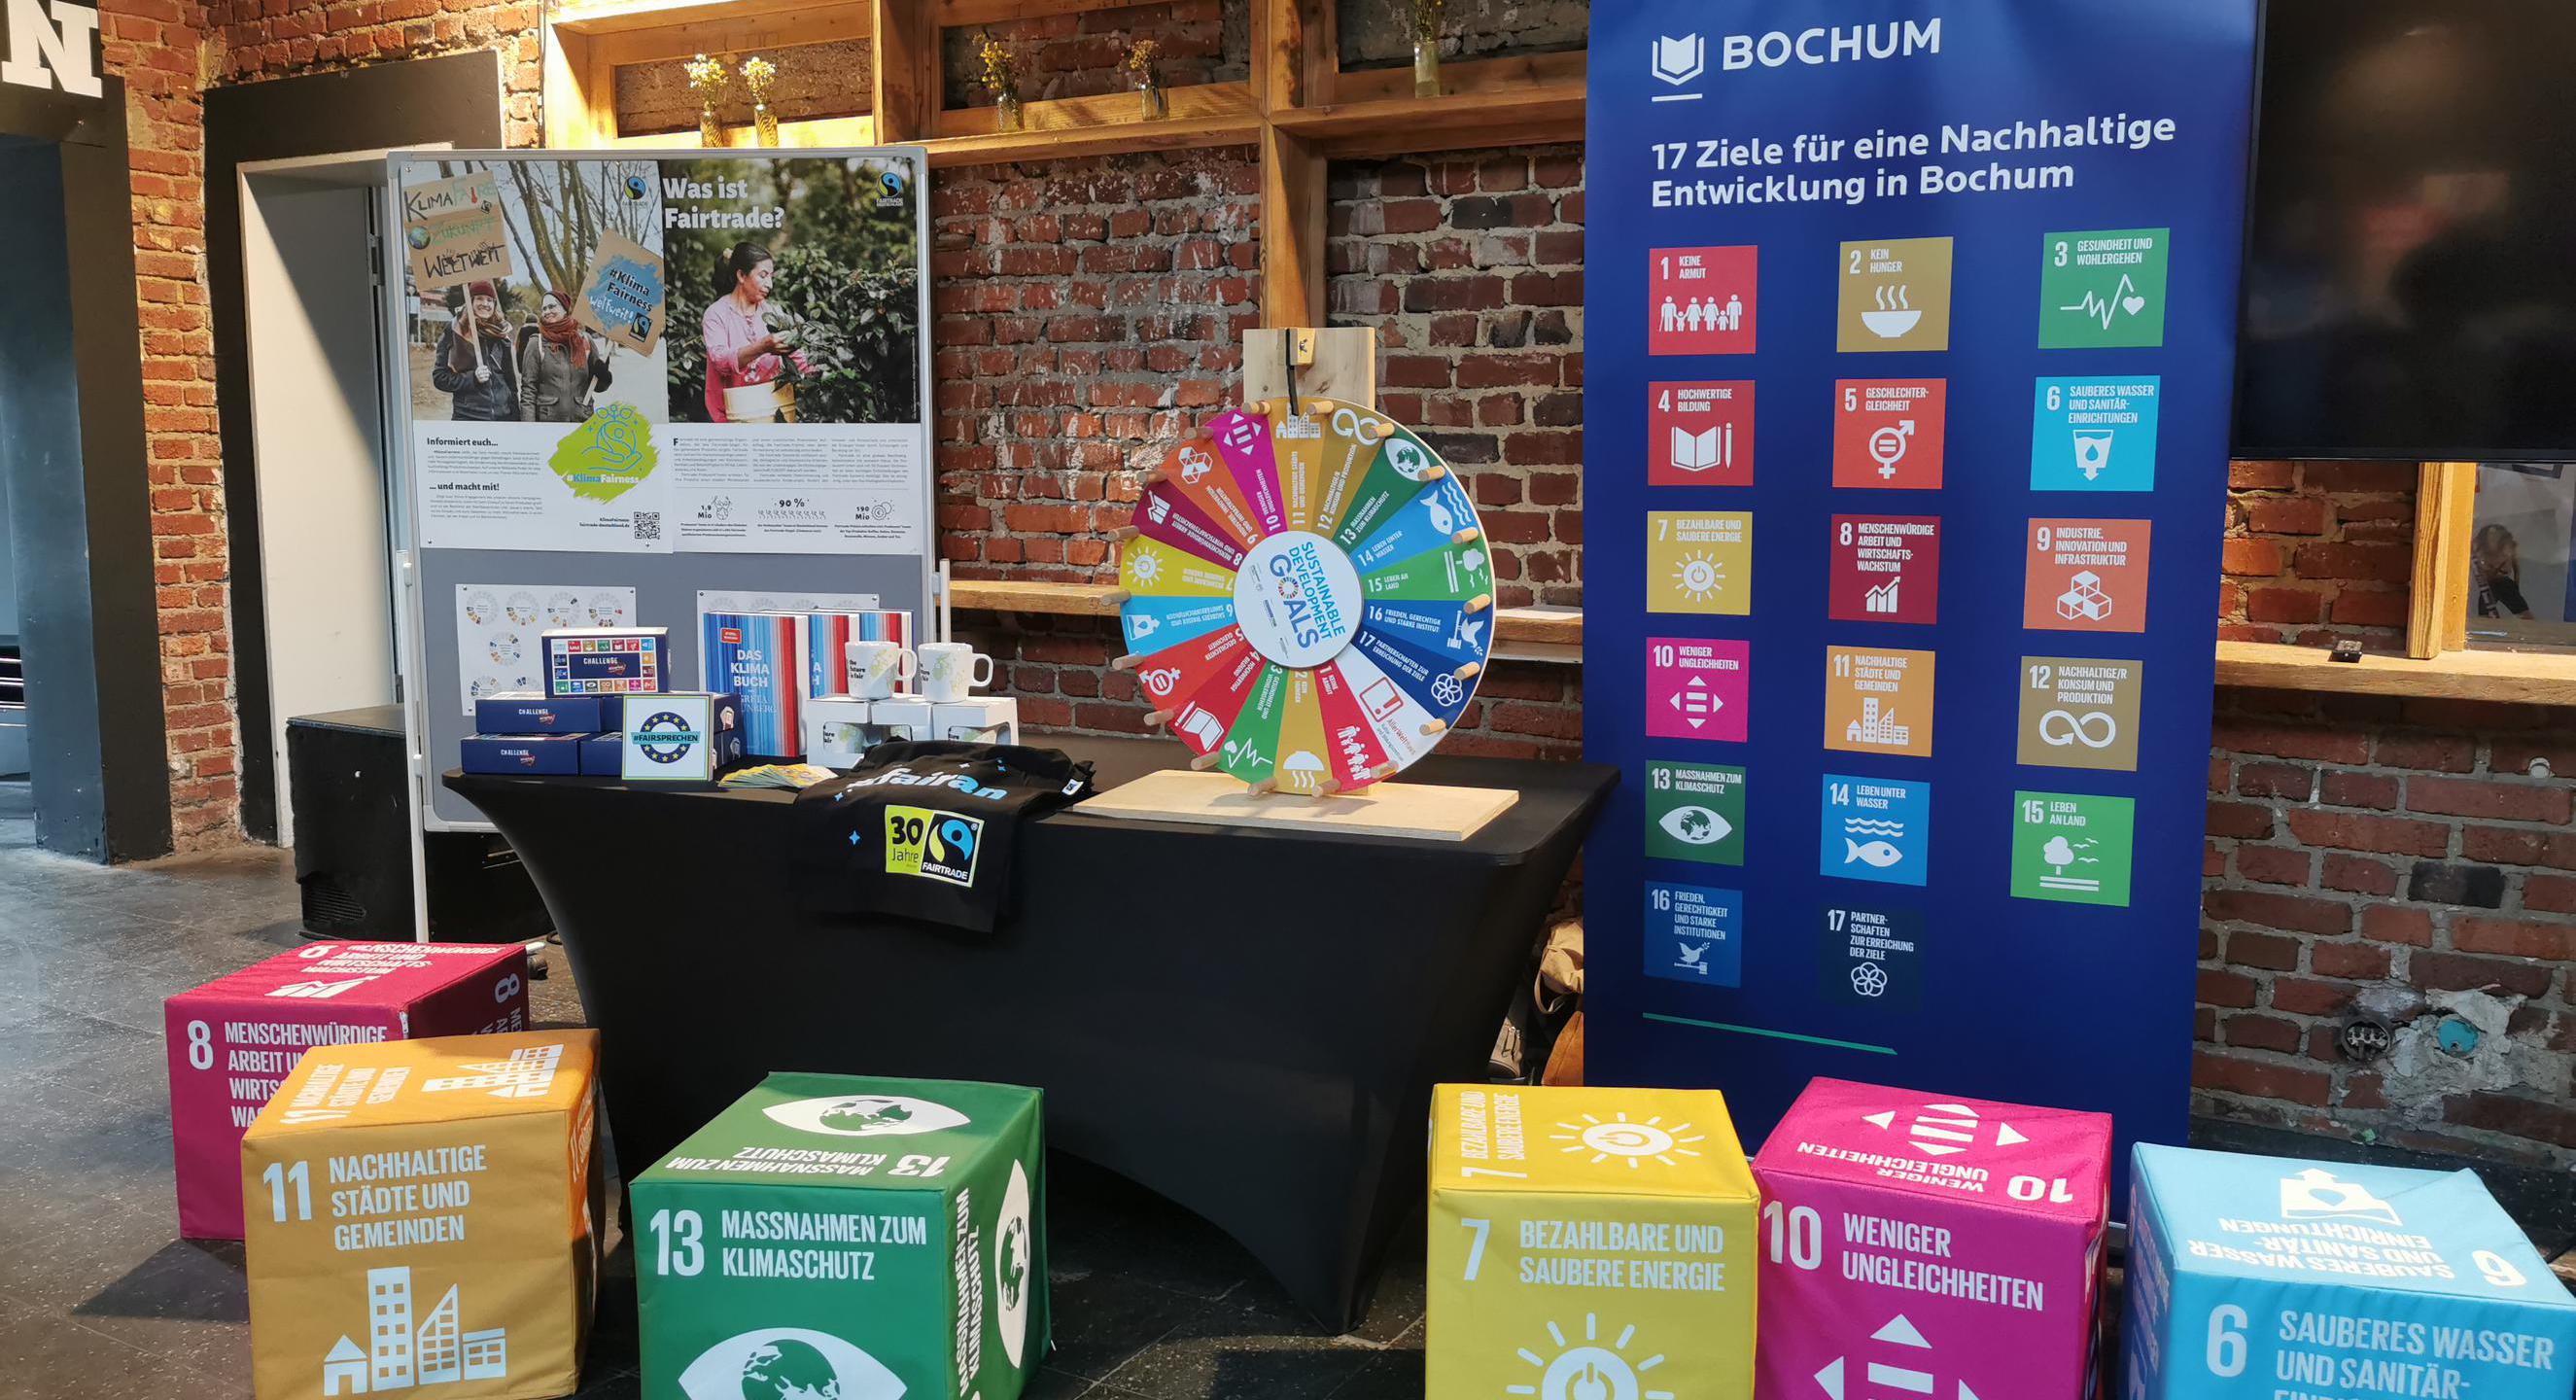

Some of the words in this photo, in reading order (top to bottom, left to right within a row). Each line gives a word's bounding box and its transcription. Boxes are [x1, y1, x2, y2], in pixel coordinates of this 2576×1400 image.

[1723, 18, 1941, 71] BOCHUM
[1652, 142, 1688, 170] 17
[1696, 138, 1784, 168] Ziele
[1793, 134, 1845, 164] für
[1854, 128, 1928, 160] eine
[1940, 113, 2176, 155] Nachhaltige
[663, 178, 713, 199] Was
[718, 176, 748, 199] ist
[1652, 173, 1865, 207] Entwicklung
[1876, 168, 1907, 197] in
[1920, 160, 2073, 194] Bochum
[404, 192, 453, 223] KLIMA
[665, 207, 784, 229] Fairtrade?
[1850, 249, 1862, 274] 2
[1870, 249, 1889, 260] KEIN
[2054, 241, 2068, 267] 3
[2077, 239, 2132, 252] GESUNDHEIT
[2134, 238, 2153, 250] UND
[2076, 252, 2142, 265] WOHLERGEHEN
[1660, 257, 1669, 280] 1
[1679, 256, 1701, 266] KEINE
[1679, 268, 1706, 279] ARMUT
[1870, 262, 1902, 273] HUNGER
[609, 267, 650, 297] #Klima
[607, 281, 653, 312] Fairness
[1658, 390, 1670, 412] 4
[1678, 389, 1732, 400] HOCHWERTIGE
[1678, 402, 1711, 412] BILDUNG
[1844, 388, 1857, 412] 5
[1865, 387, 1929, 399] GESCHLECHTER-
[1865, 401, 1910, 411] GLEICHHEIT
[2046, 386, 2061, 410] 6
[2070, 385, 2115, 397] SAUBERES
[2117, 385, 2154, 396] WASSER
[2069, 399, 2088, 410] UND
[2089, 398, 2130, 410] SANITÄR-
[2068, 412, 2139, 424] EINRICHTUNGEN
[427, 438, 470, 446] Informiert
[567, 473, 640, 484] #KlimaFairness
[1340, 528, 1357, 545] 13
[1657, 519, 1668, 542] 7
[1676, 519, 1724, 530] BEZAHLBARE
[1725, 519, 1742, 530] UND
[1676, 531, 1710, 542] SAUBERE
[1711, 532, 1742, 542] ENERGIE
[1839, 522, 1852, 545] 8
[1858, 523, 1934, 536] MENSCHENWÜRDIGE
[1858, 536, 1885, 546] ARBEIT
[1886, 537, 1902, 547] UND
[2036, 526, 2051, 551] 9
[1358, 549, 1375, 567] 14
[1857, 548, 1913, 560] WIRTSCHAFTS-
[2055, 541, 2107, 552] INNOVATION
[2107, 542, 2127, 553] UND
[1857, 560, 1900, 573] WACHSTUM
[2055, 554, 2126, 566] INFRASTRUKTUR
[1289, 547, 1333, 639] DEVELOPMENT
[1302, 542, 1345, 636] SUSTAINABLE
[1368, 578, 1382, 592] 15
[1369, 606, 1383, 621] 16
[1359, 631, 1375, 648] 17
[737, 649, 762, 660] DAS
[1654, 645, 1673, 668] 10
[1679, 646, 1712, 657] WENIGER
[1679, 658, 1739, 671] UNGLEICHHEITEN
[731, 662, 770, 675] KLIMA
[1833, 654, 1850, 678] 11
[1855, 655, 1908, 669] NACHHALTIGE
[1855, 667, 1884, 680] STÄDTE
[1884, 669, 1901, 681] UND
[2030, 665, 2051, 689] 12
[2058, 666, 2127, 680] NACHHALTIGE/R
[734, 675, 768, 687] BUCH
[1855, 681, 1898, 692] GEMEINDEN
[2058, 680, 2096, 691] KONSUM
[2096, 681, 2114, 692] UND
[2057, 691, 2113, 705] PRODUKTION
[633, 733, 698, 743] #FAIRSPRECHEN
[1652, 768, 1671, 790] 13
[1676, 769, 1725, 783] MASSNAHMEN
[1725, 772, 1742, 785] ZUM
[1675, 781, 1725, 794] KLIMASCHUTZ
[1829, 783, 1849, 806] 14
[1857, 785, 1880, 796] LEBEN
[1880, 787, 1906, 799] UNTER
[1856, 796, 1889, 810] WASSER
[2022, 800, 2044, 823] 15
[2050, 801, 2077, 813] LEBEN
[2049, 814, 2062, 825] AN
[2063, 815, 2086, 826] LAND
[890, 816, 923, 846] 30
[891, 848, 920, 863] Jahre
[922, 861, 968, 880] FAIRTRADE
[1652, 889, 1670, 911] 16
[1675, 903, 1728, 918] GERECHTIGKEIT
[1674, 914, 1689, 925] UND
[1828, 909, 1846, 932] 17
[1851, 911, 1888, 925] PARTNER-
[1850, 923, 1890, 937] SCHAFTEN
[1674, 925, 1726, 940] INSTITUTIONEN
[1850, 934, 1865, 946] ZUR
[1866, 936, 1914, 952] ERREICHUNG
[1850, 946, 1865, 958] DER
[1865, 948, 1886, 961] ZIELE
[187, 1019, 214, 1069] 8
[224, 1021, 387, 1045] MENSCHENWÜRDIGE
[228, 1050, 283, 1072] ARBEIT
[667, 1156, 715, 1171] ZUM
[714, 1158, 874, 1175] MASSNAHMEN
[732, 1146, 887, 1166] KLIMASCHUTZ
[888, 1154, 951, 1177] 13
[1797, 1141, 1989, 1182] UNGLEICHHEITEN
[262, 1160, 312, 1222] 11
[329, 1145, 487, 1183] NACHHALTIGE
[1876, 1169, 1984, 1193] WENIGER
[2006, 1174, 2073, 1204] 10
[331, 1180, 418, 1217] STÄDTE
[422, 1180, 470, 1209] UND
[334, 1214, 465, 1251] GEMEINDEN
[649, 1208, 705, 1277] 13
[721, 1209, 876, 1243] MASSNAHMEN
[880, 1215, 927, 1245] ZUM
[1763, 1200, 1823, 1271] 10
[1843, 1211, 1951, 1259] WENIGER
[2218, 1217, 2433, 1249] EINRICHTUNGEN
[1461, 1217, 1490, 1281] 7
[1519, 1219, 1670, 1252] BEZAHLBARE
[1675, 1223, 1723, 1254] UND
[2187, 1240, 2301, 1270] WASSER
[2255, 1236, 2381, 1262] SANITÄR-
[2388, 1247, 2446, 1265] UND
[722, 1247, 875, 1280] KLIMASCHUTZ
[1518, 1256, 1624, 1287] SAUBERE
[1629, 1260, 1725, 1292] ENERGIE
[2306, 1255, 2455, 1279] SAUBERES
[2472, 1249, 2527, 1287] 6
[1842, 1250, 2043, 1312] UNGLEICHHEITEN
[2206, 1304, 2248, 1378] 6
[2279, 1309, 2425, 1355] SAUBERES
[2432, 1324, 2555, 1371] WASSER
[2276, 1349, 2333, 1387] UND
[2340, 1358, 2471, 1400] SANITÄR-
